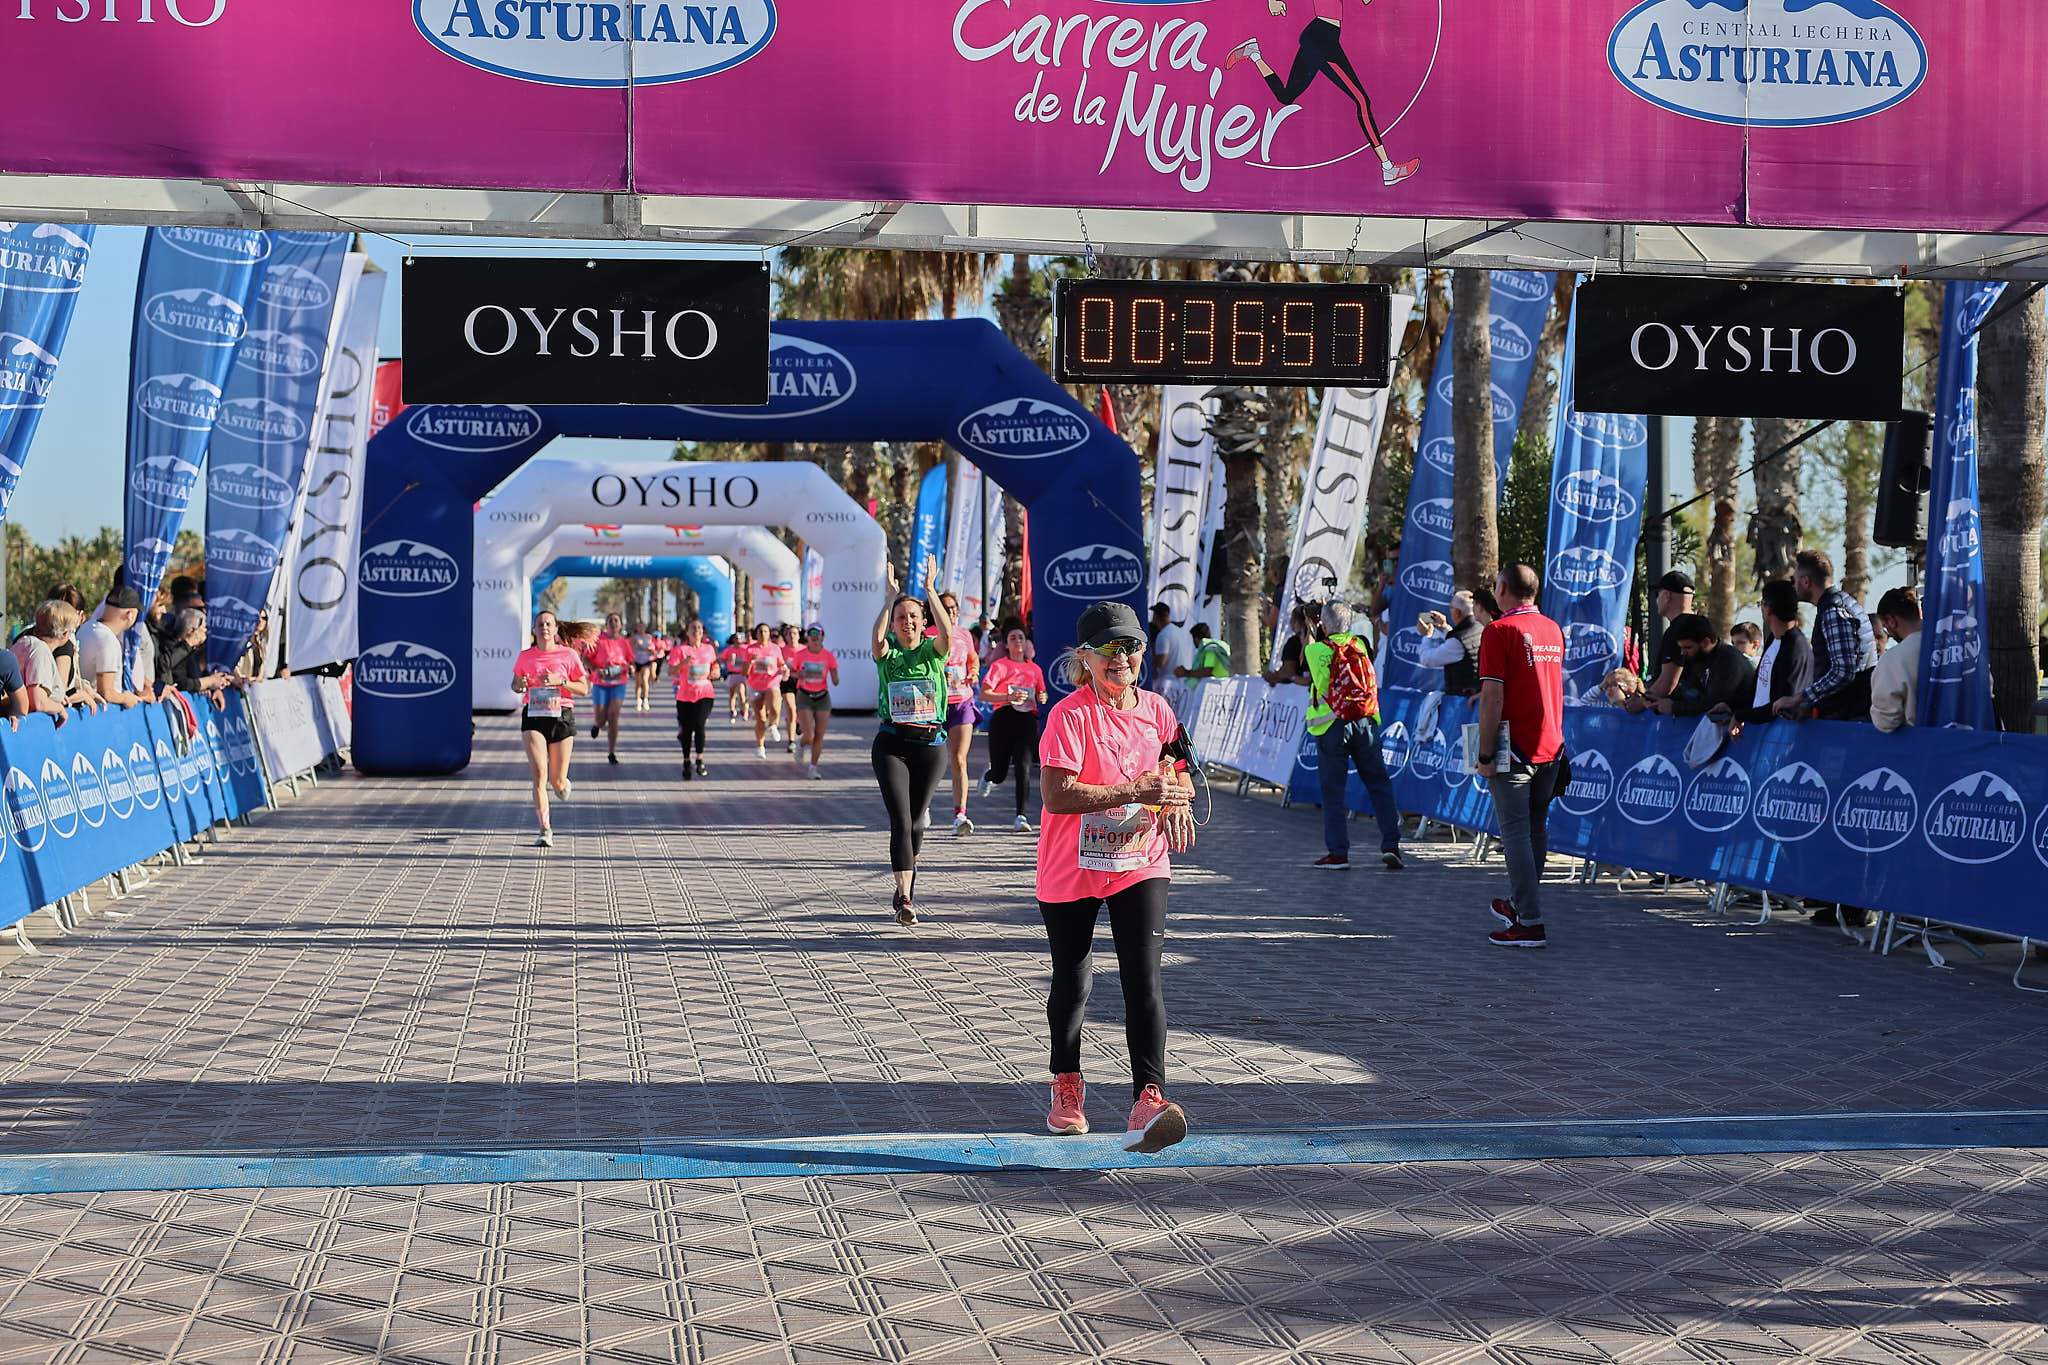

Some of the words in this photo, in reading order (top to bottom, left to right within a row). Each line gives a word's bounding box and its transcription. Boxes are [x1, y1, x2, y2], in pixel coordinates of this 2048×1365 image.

[441, 0, 749, 45] ASTURIANA
[952, 0, 1208, 72] Carrera
[1683, 21, 1781, 37] CENTRAL
[1792, 24, 1892, 41] LECHERA
[1632, 22, 1903, 87] ASTURIANA
[1014, 71, 1061, 123] de
[1073, 71, 1106, 126] la
[1099, 67, 1303, 193] Mujer
[0, 247, 86, 284] URIANA
[261, 281, 323, 303] STURIANA
[1490, 271, 1543, 296] STURIANA
[151, 301, 239, 338] ASTURIAN
[464, 304, 718, 360] OYSHO
[1081, 297, 1365, 367] 00:36:57
[770, 357, 834, 368] ECHERA
[1630, 322, 1857, 375] OYSHO
[415, 413, 531, 437] ASTURIANA
[970, 422, 1081, 444] ASTURIANA
[592, 474, 758, 509] OYSHO
[489, 511, 541, 522] OYSHO
[807, 511, 856, 523] OYSHO
[209, 547, 273, 568] STURIANA
[361, 560, 451, 583] ASTURIANA
[832, 581, 878, 593] OYSHO
[1052, 566, 1138, 587] ASTURIANA
[473, 649, 513, 660] YSHO
[359, 661, 449, 684] ASTURIANA
[1564, 781, 1607, 800] STURIANA
[1619, 778, 1676, 809] ASTURIANA
[1688, 783, 1745, 816] ASTURIANA
[1757, 788, 1822, 824] ASTURIANA
[1837, 797, 1908, 832] ASTURIANA
[1929, 803, 2016, 844] ASTURIANA
